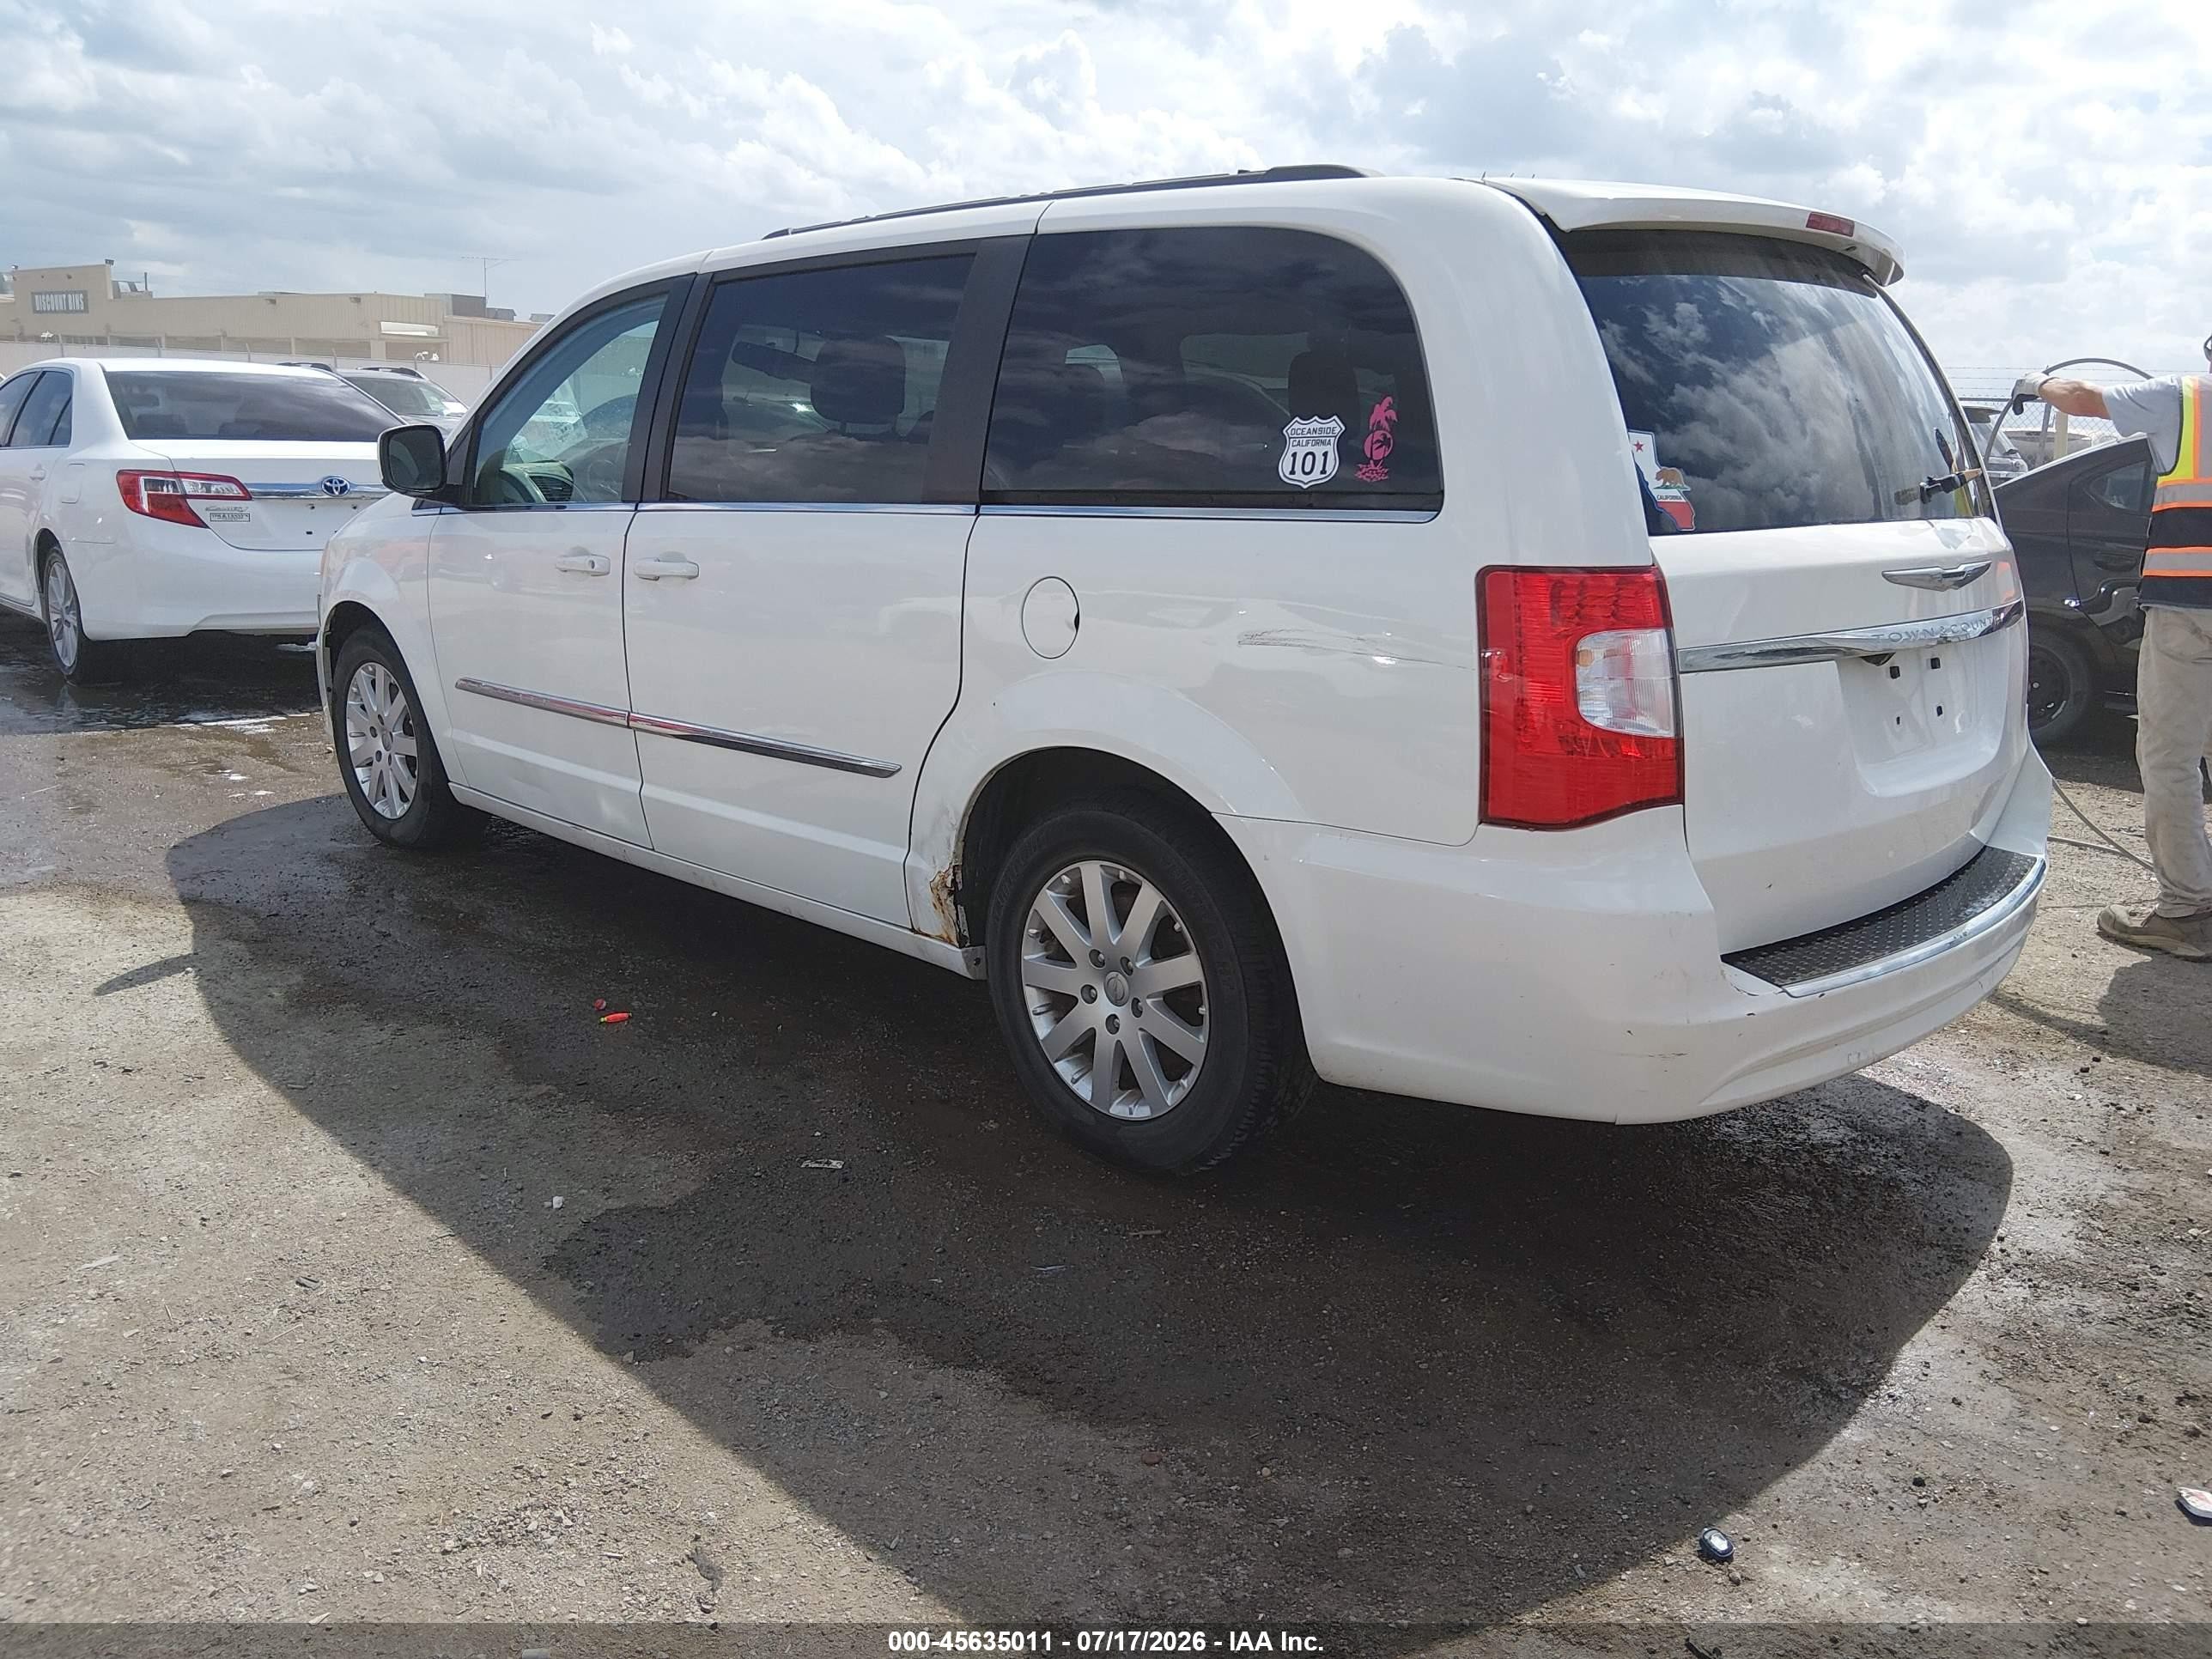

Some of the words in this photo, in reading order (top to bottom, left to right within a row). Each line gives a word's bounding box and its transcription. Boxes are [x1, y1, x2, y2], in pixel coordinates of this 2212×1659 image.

[35, 294, 66, 311] DISCOUNT
[69, 293, 84, 310] BINS
[1290, 426, 1337, 436] OCEANSIDE
[1291, 438, 1332, 447] CALIFORNIA
[1289, 451, 1329, 476] 101
